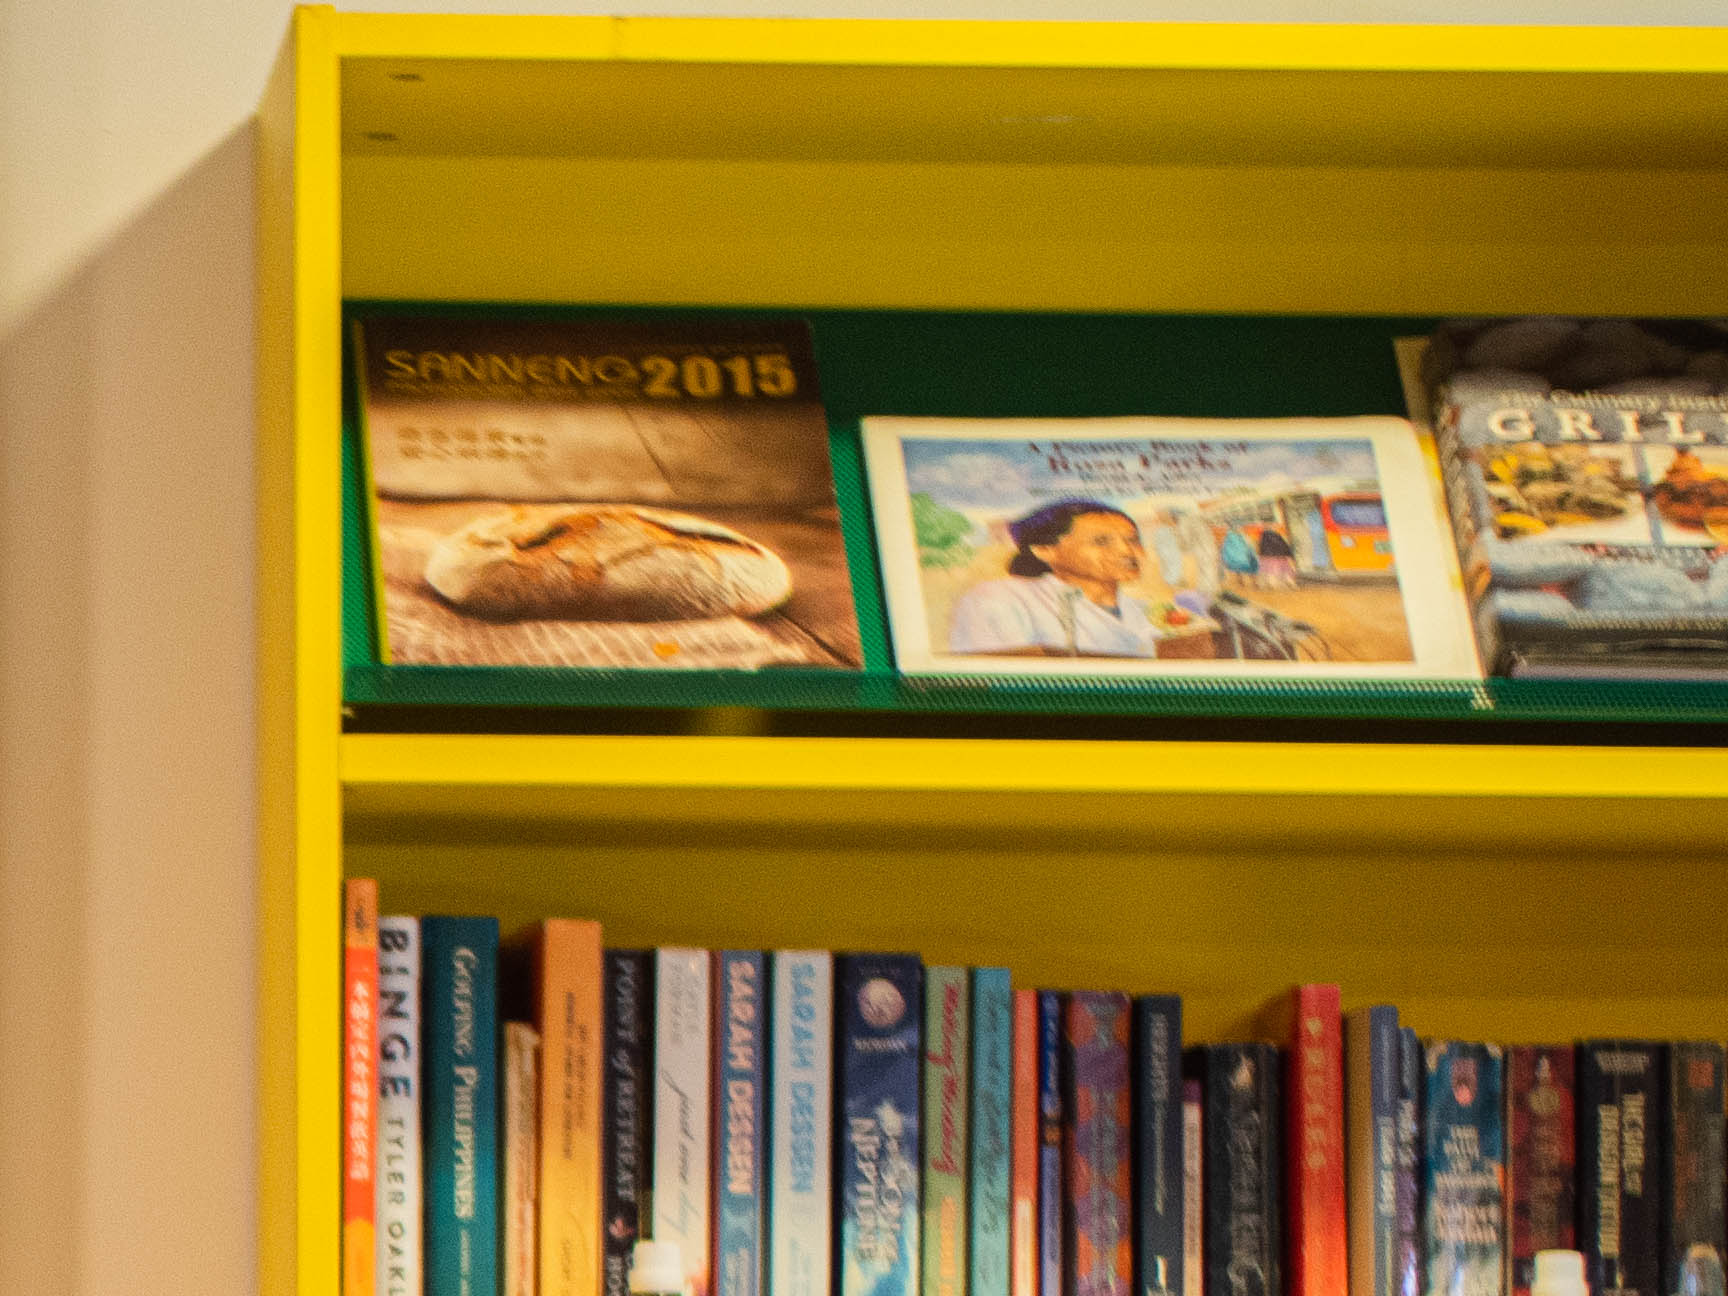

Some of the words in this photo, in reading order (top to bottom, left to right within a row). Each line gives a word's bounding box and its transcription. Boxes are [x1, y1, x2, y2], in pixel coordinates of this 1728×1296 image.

[640, 353, 798, 399] 2015
[1486, 407, 1728, 443] GRIL
[452, 946, 478, 1057] GOLFING
[726, 959, 754, 1072] SARAH
[790, 961, 815, 1072] SARAH
[384, 1115, 406, 1205] TYLER
[453, 1064, 477, 1219] PHILIPPINES
[614, 1079, 635, 1201] RETREAT
[725, 1079, 754, 1195] DESSEN
[788, 1080, 814, 1194] DESSEN
